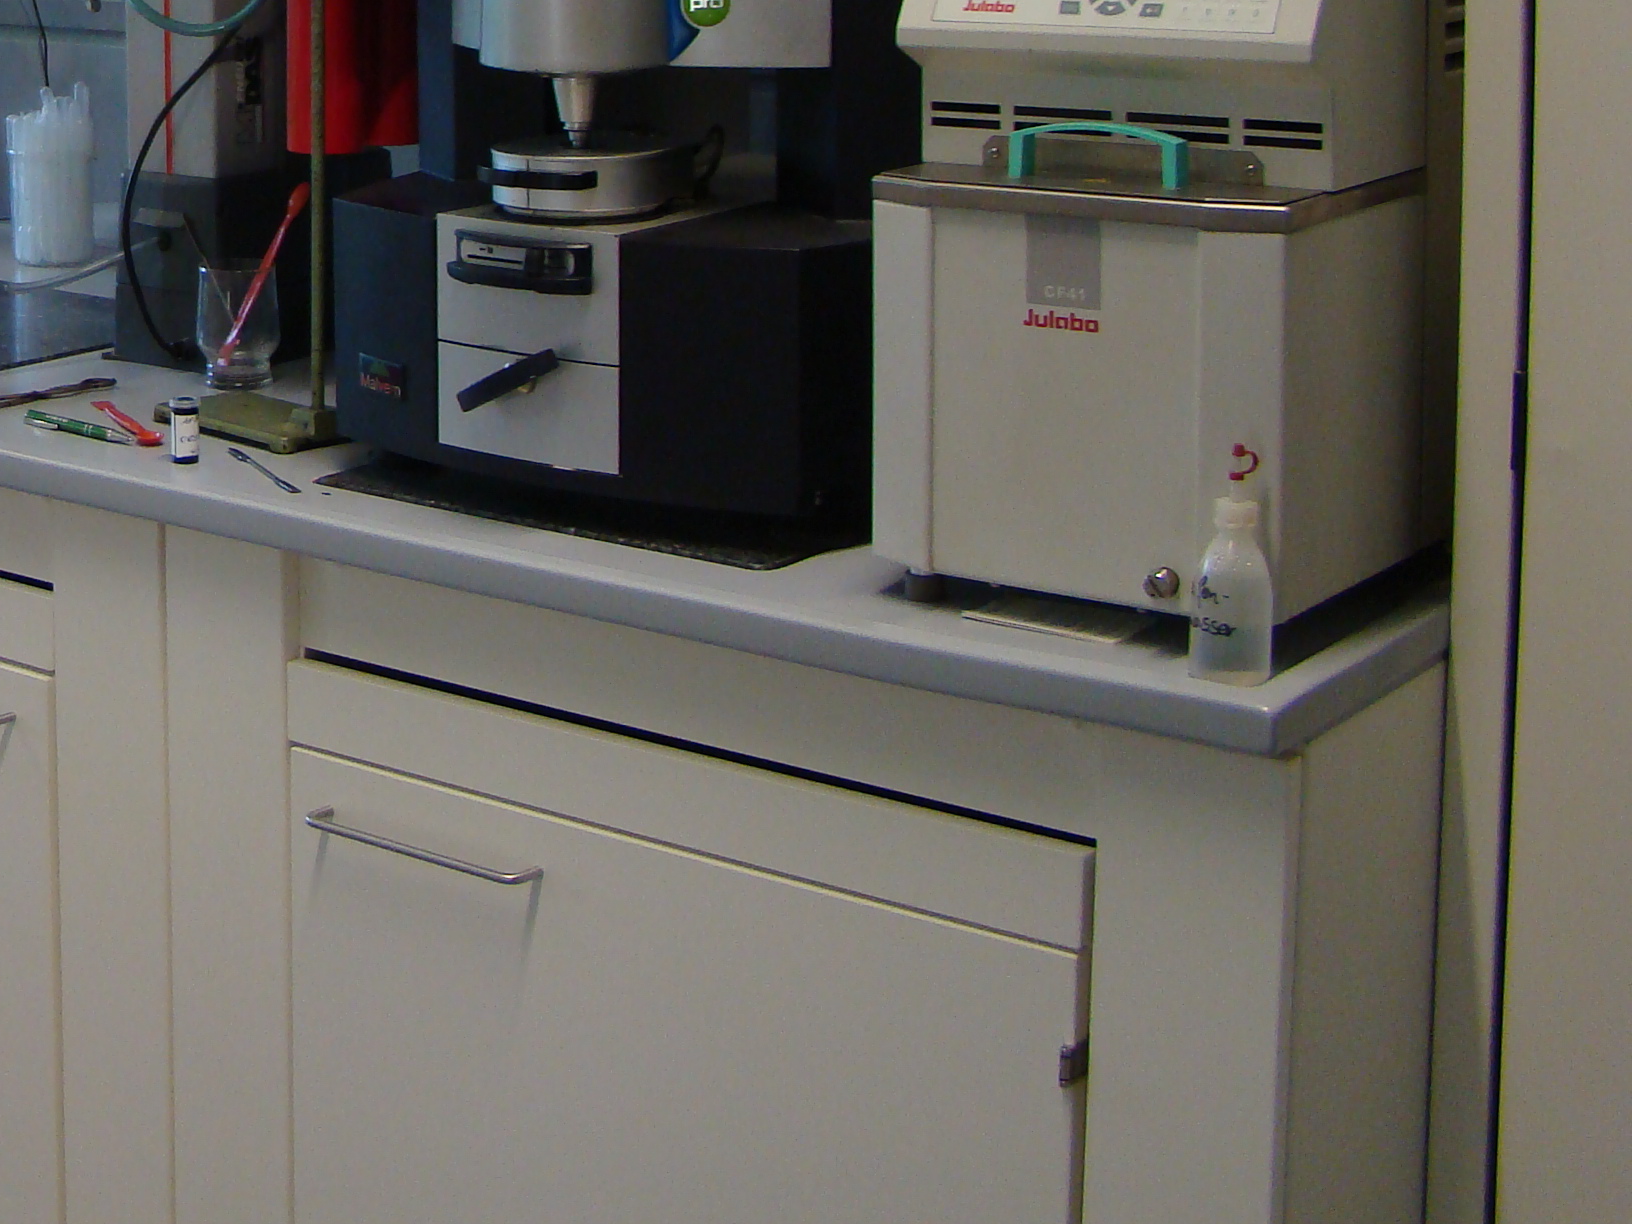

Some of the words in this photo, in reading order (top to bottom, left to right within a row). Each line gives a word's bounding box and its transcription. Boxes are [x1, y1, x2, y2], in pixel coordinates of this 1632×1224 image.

[962, 0, 1015, 13] Julabo
[1023, 308, 1099, 334] Julabo
[360, 372, 401, 398] Malvern
